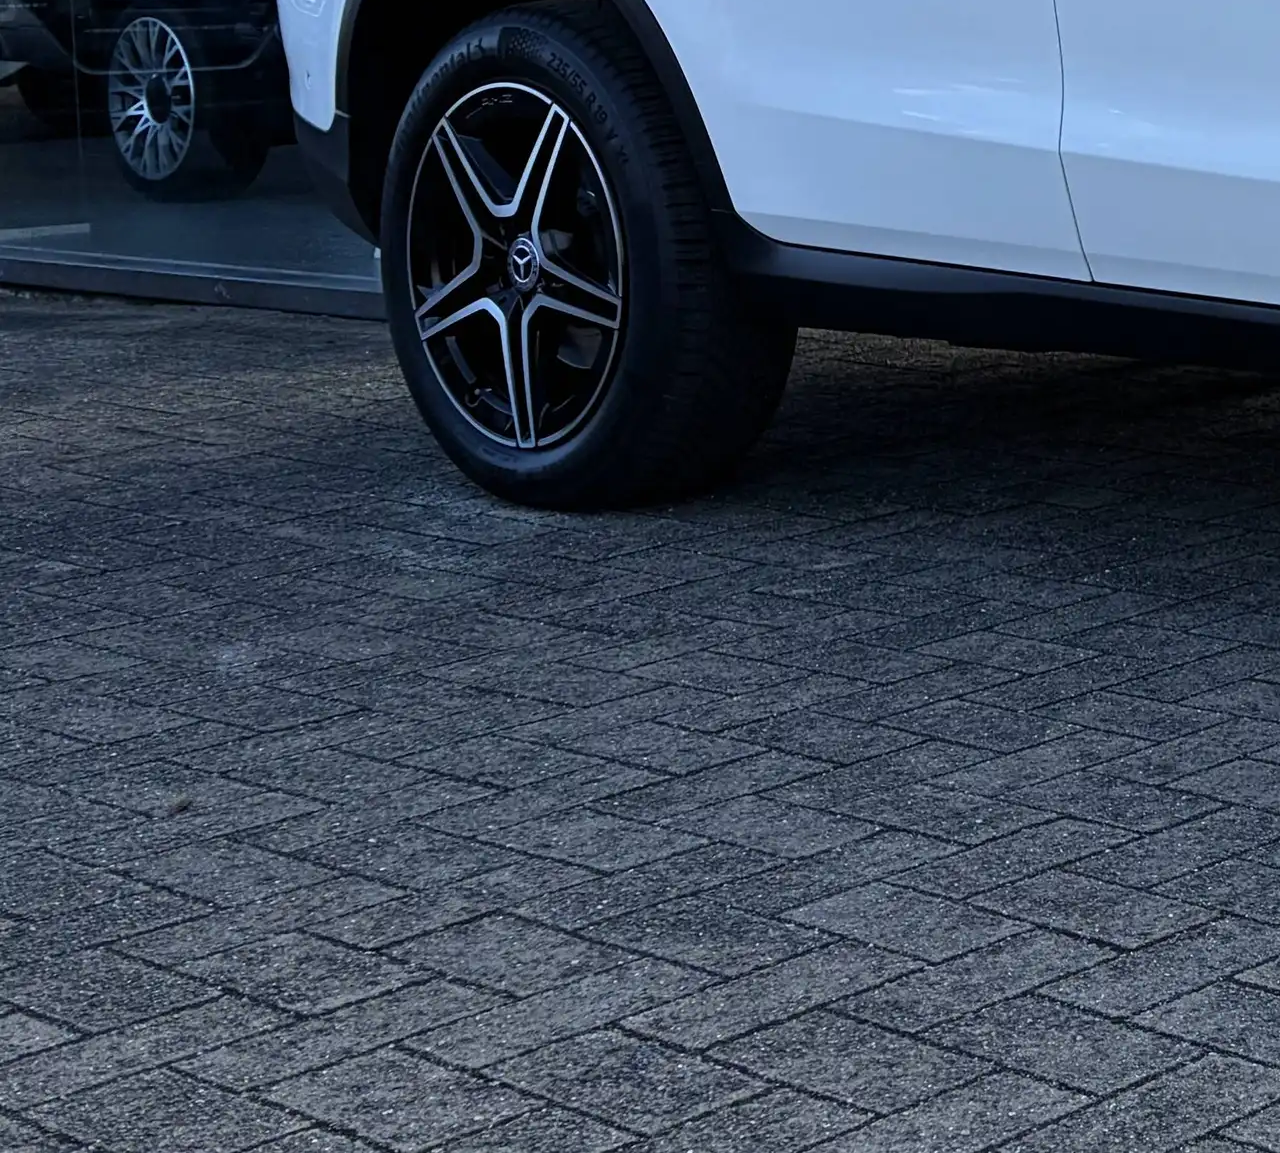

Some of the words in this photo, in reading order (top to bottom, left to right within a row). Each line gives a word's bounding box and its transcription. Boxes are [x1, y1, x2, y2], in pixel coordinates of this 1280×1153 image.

[547, 52, 587, 95] 235/55
[585, 92, 596, 112] R
[594, 104, 608, 124] 19
